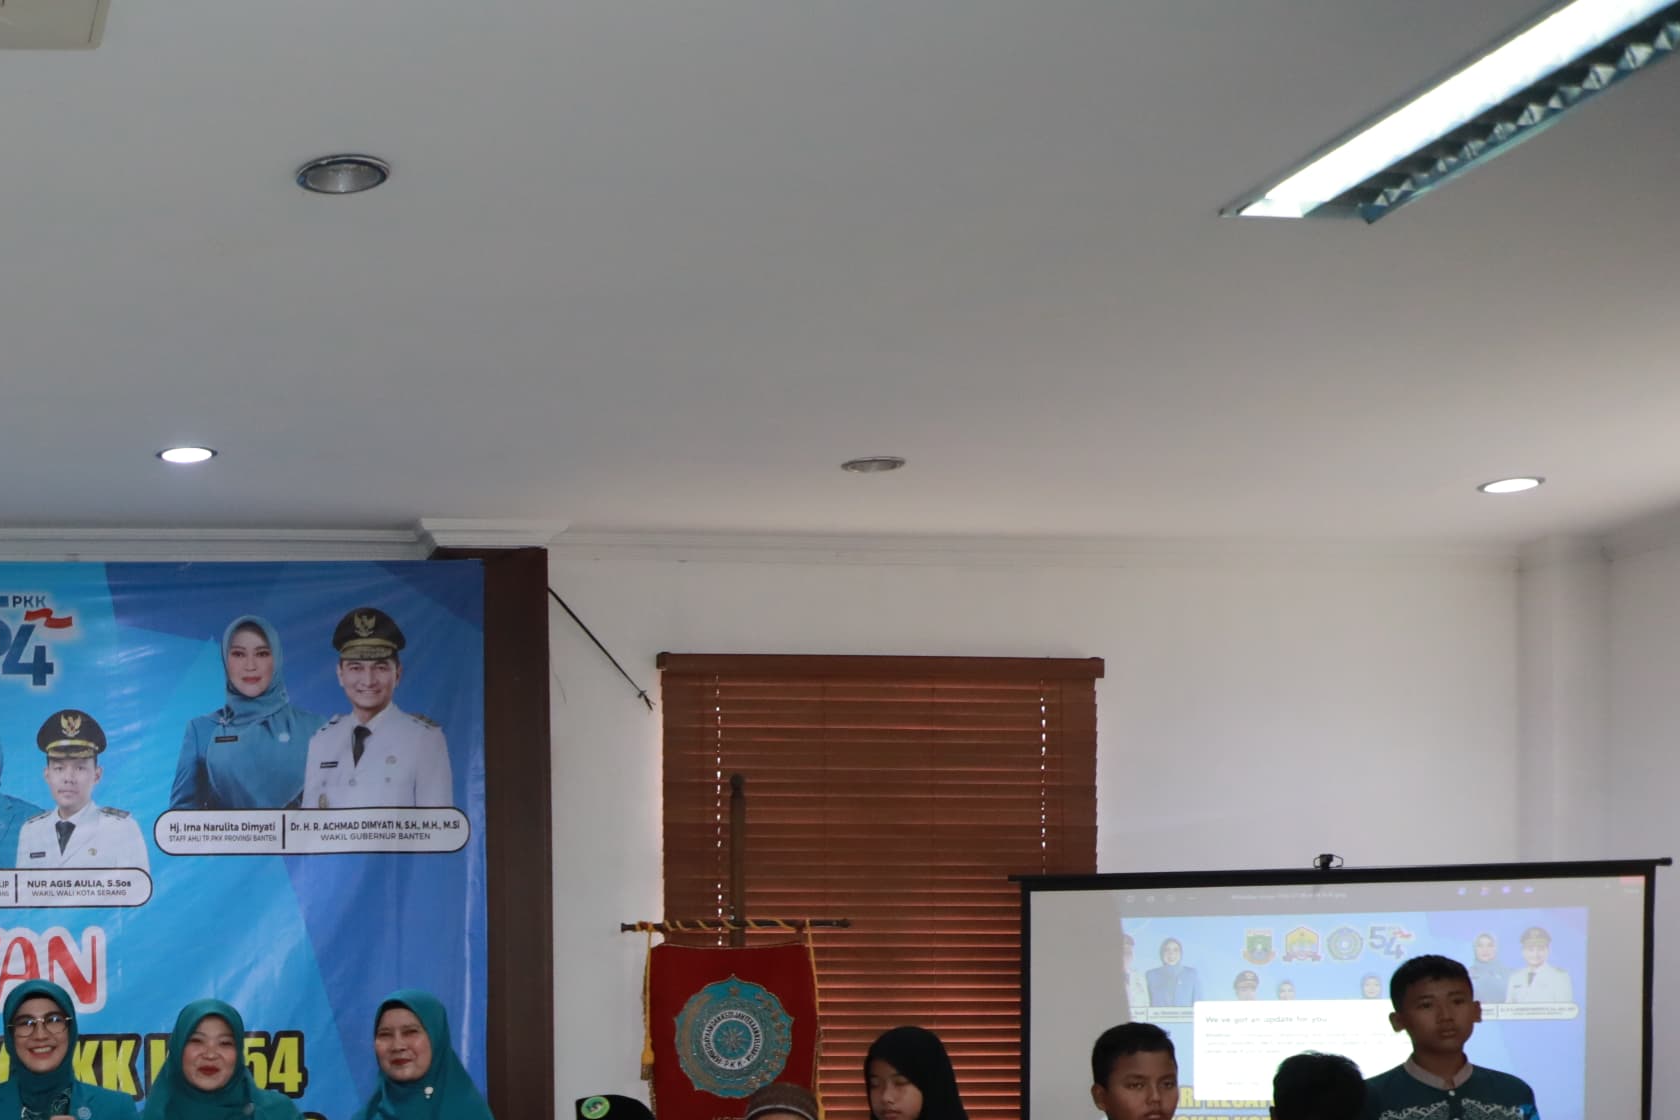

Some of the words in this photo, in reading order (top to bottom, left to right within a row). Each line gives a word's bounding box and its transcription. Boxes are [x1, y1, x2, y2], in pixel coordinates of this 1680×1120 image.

[12, 595, 46, 608] PKK
[170, 823, 182, 833] Hj.
[184, 823, 201, 831] Irna
[203, 822, 239, 831] Narulita
[241, 822, 276, 833] Dimyati
[290, 822, 302, 831] Dr.
[304, 822, 312, 831] H.
[313, 822, 321, 831] R.
[323, 822, 359, 830] ACHMAD
[361, 821, 394, 830] DIMYATI
[443, 821, 460, 829] M.Si
[27, 880, 47, 888] NUR
[49, 880, 72, 888] AGIS
[74, 880, 105, 889] AULIA,
[107, 879, 132, 888] S.Sos
[1264, 1015, 1293, 1025] update
